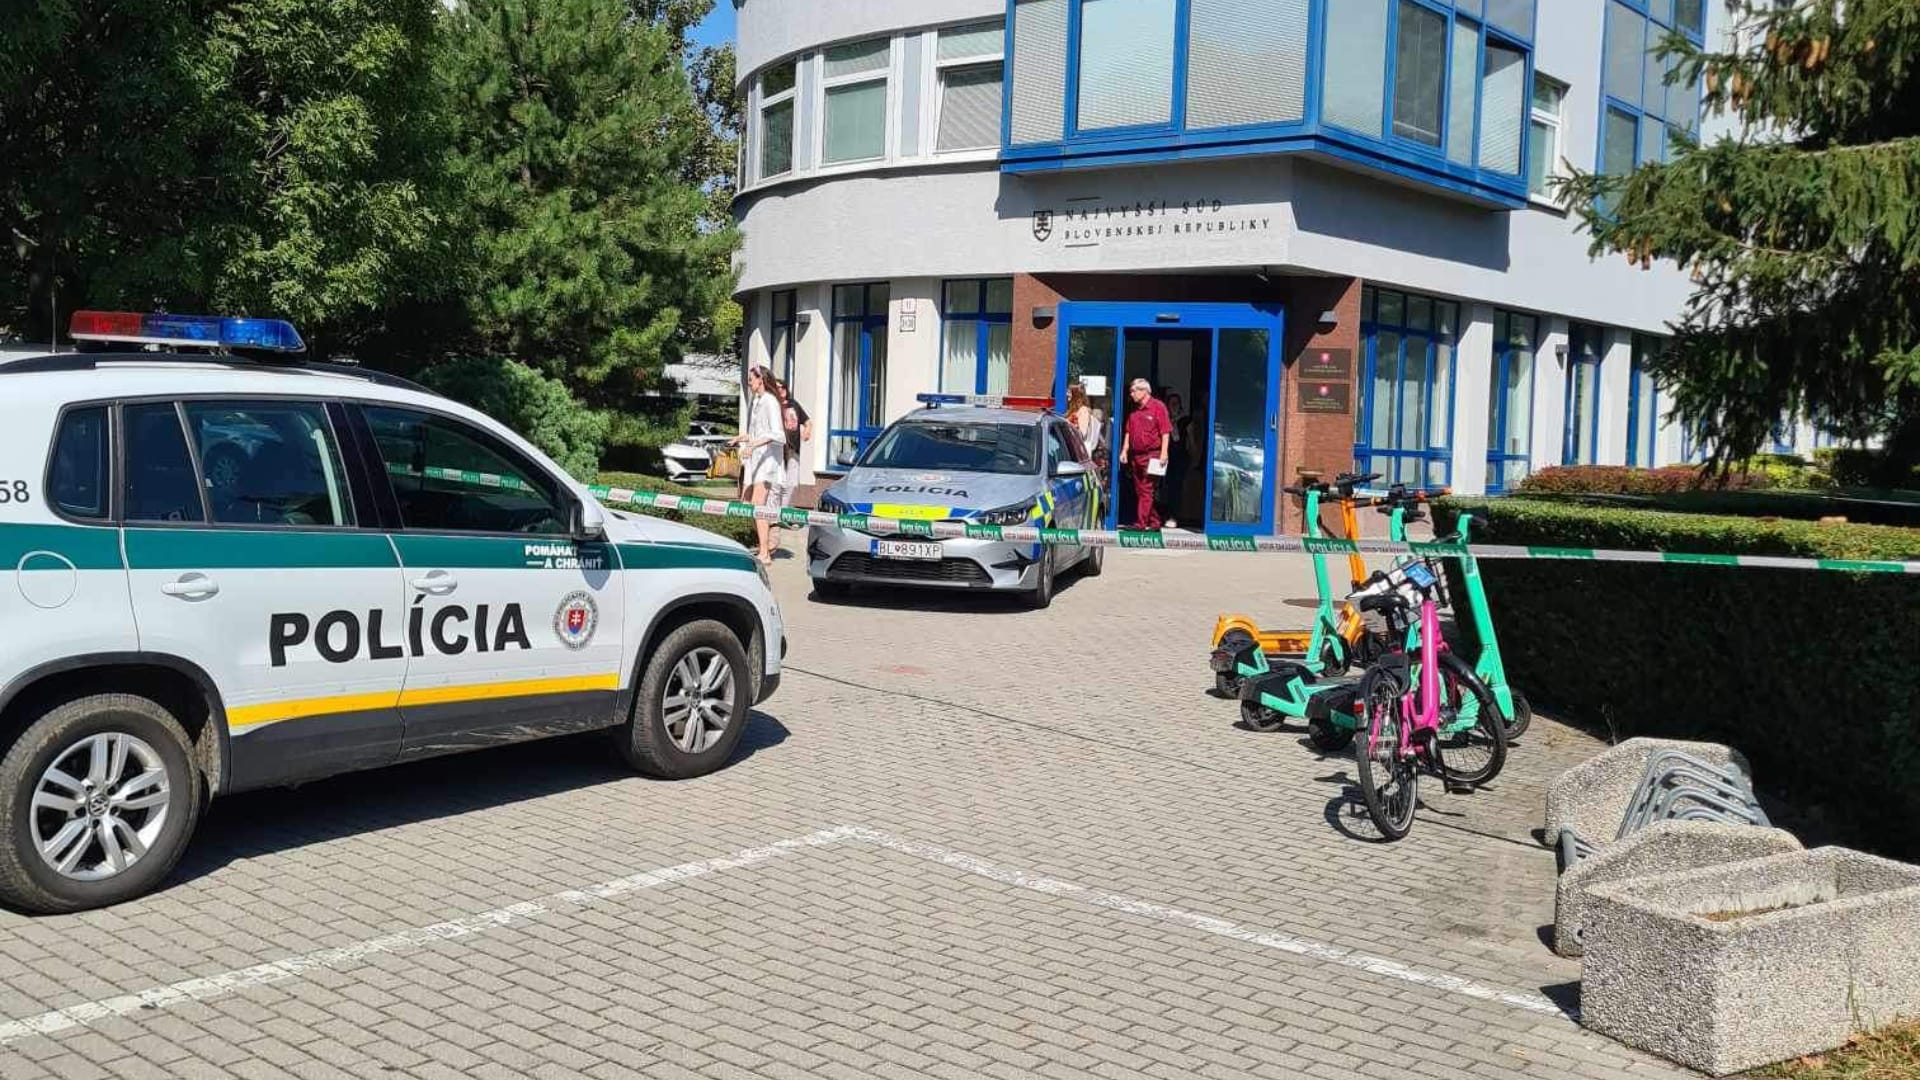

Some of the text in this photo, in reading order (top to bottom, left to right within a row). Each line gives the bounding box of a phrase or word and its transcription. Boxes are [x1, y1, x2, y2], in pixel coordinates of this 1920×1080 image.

[1064, 217, 1270, 240] SLOVENSKEJ REPUBLIKY
[1123, 534, 1161, 548] POLÍCIA
[1211, 536, 1255, 551] POLÍCIA
[270, 594, 532, 667] POLÍCIA
